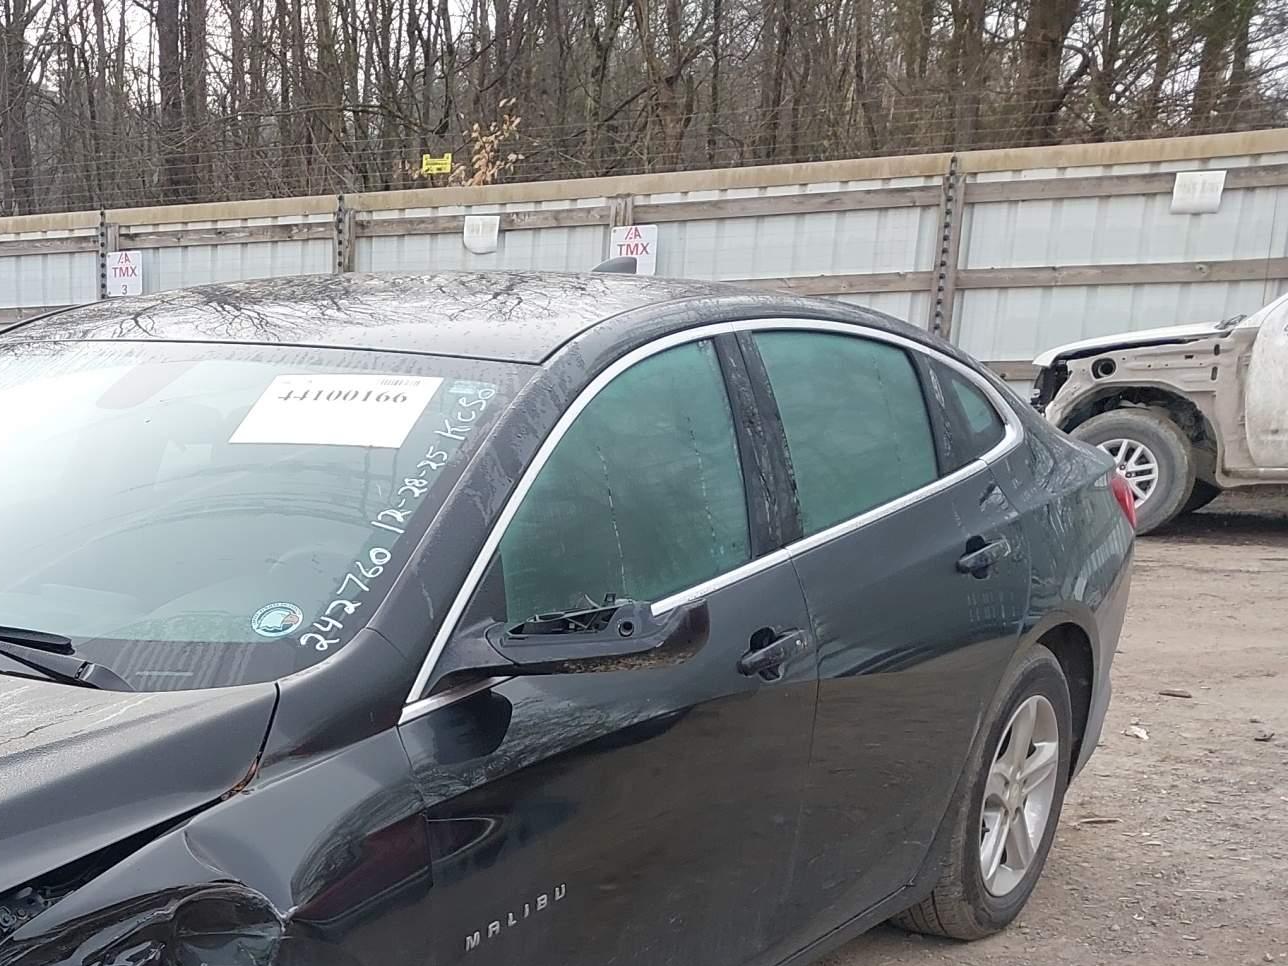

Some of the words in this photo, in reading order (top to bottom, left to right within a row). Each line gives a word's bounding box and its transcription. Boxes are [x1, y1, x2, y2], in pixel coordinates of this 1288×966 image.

[617, 242, 650, 256] TMX
[112, 266, 137, 278] TMX
[121, 284, 128, 295] 3
[278, 389, 408, 403] 44100166
[300, 547, 392, 650] 242760
[371, 446, 448, 534] 12-28-25
[465, 883, 566, 952] MALIBU
